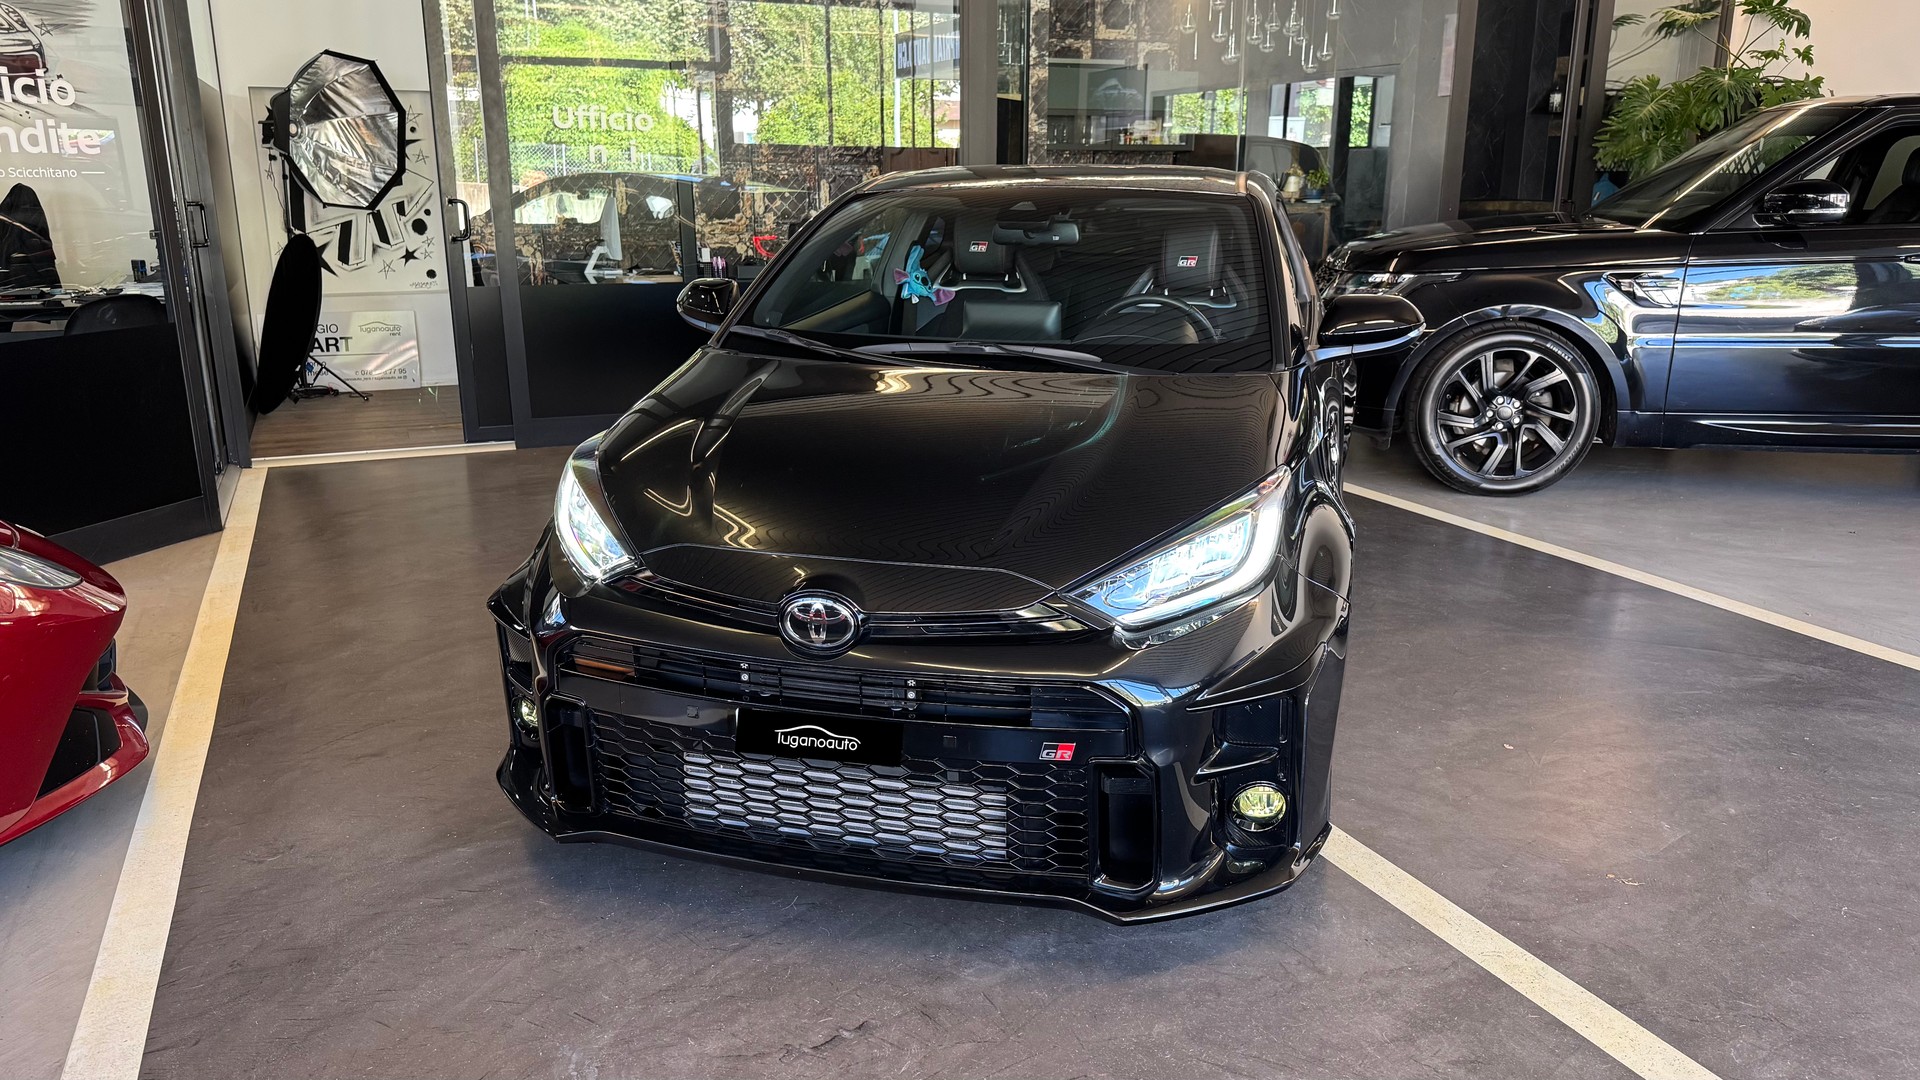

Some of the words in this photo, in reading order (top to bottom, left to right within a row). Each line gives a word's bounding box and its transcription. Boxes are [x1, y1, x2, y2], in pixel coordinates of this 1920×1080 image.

[553, 104, 653, 132] Ufficio
[8, 167, 78, 178] Scicchitano
[969, 244, 987, 252] GR
[1178, 259, 1197, 267] GR
[1040, 748, 1072, 760] GR
